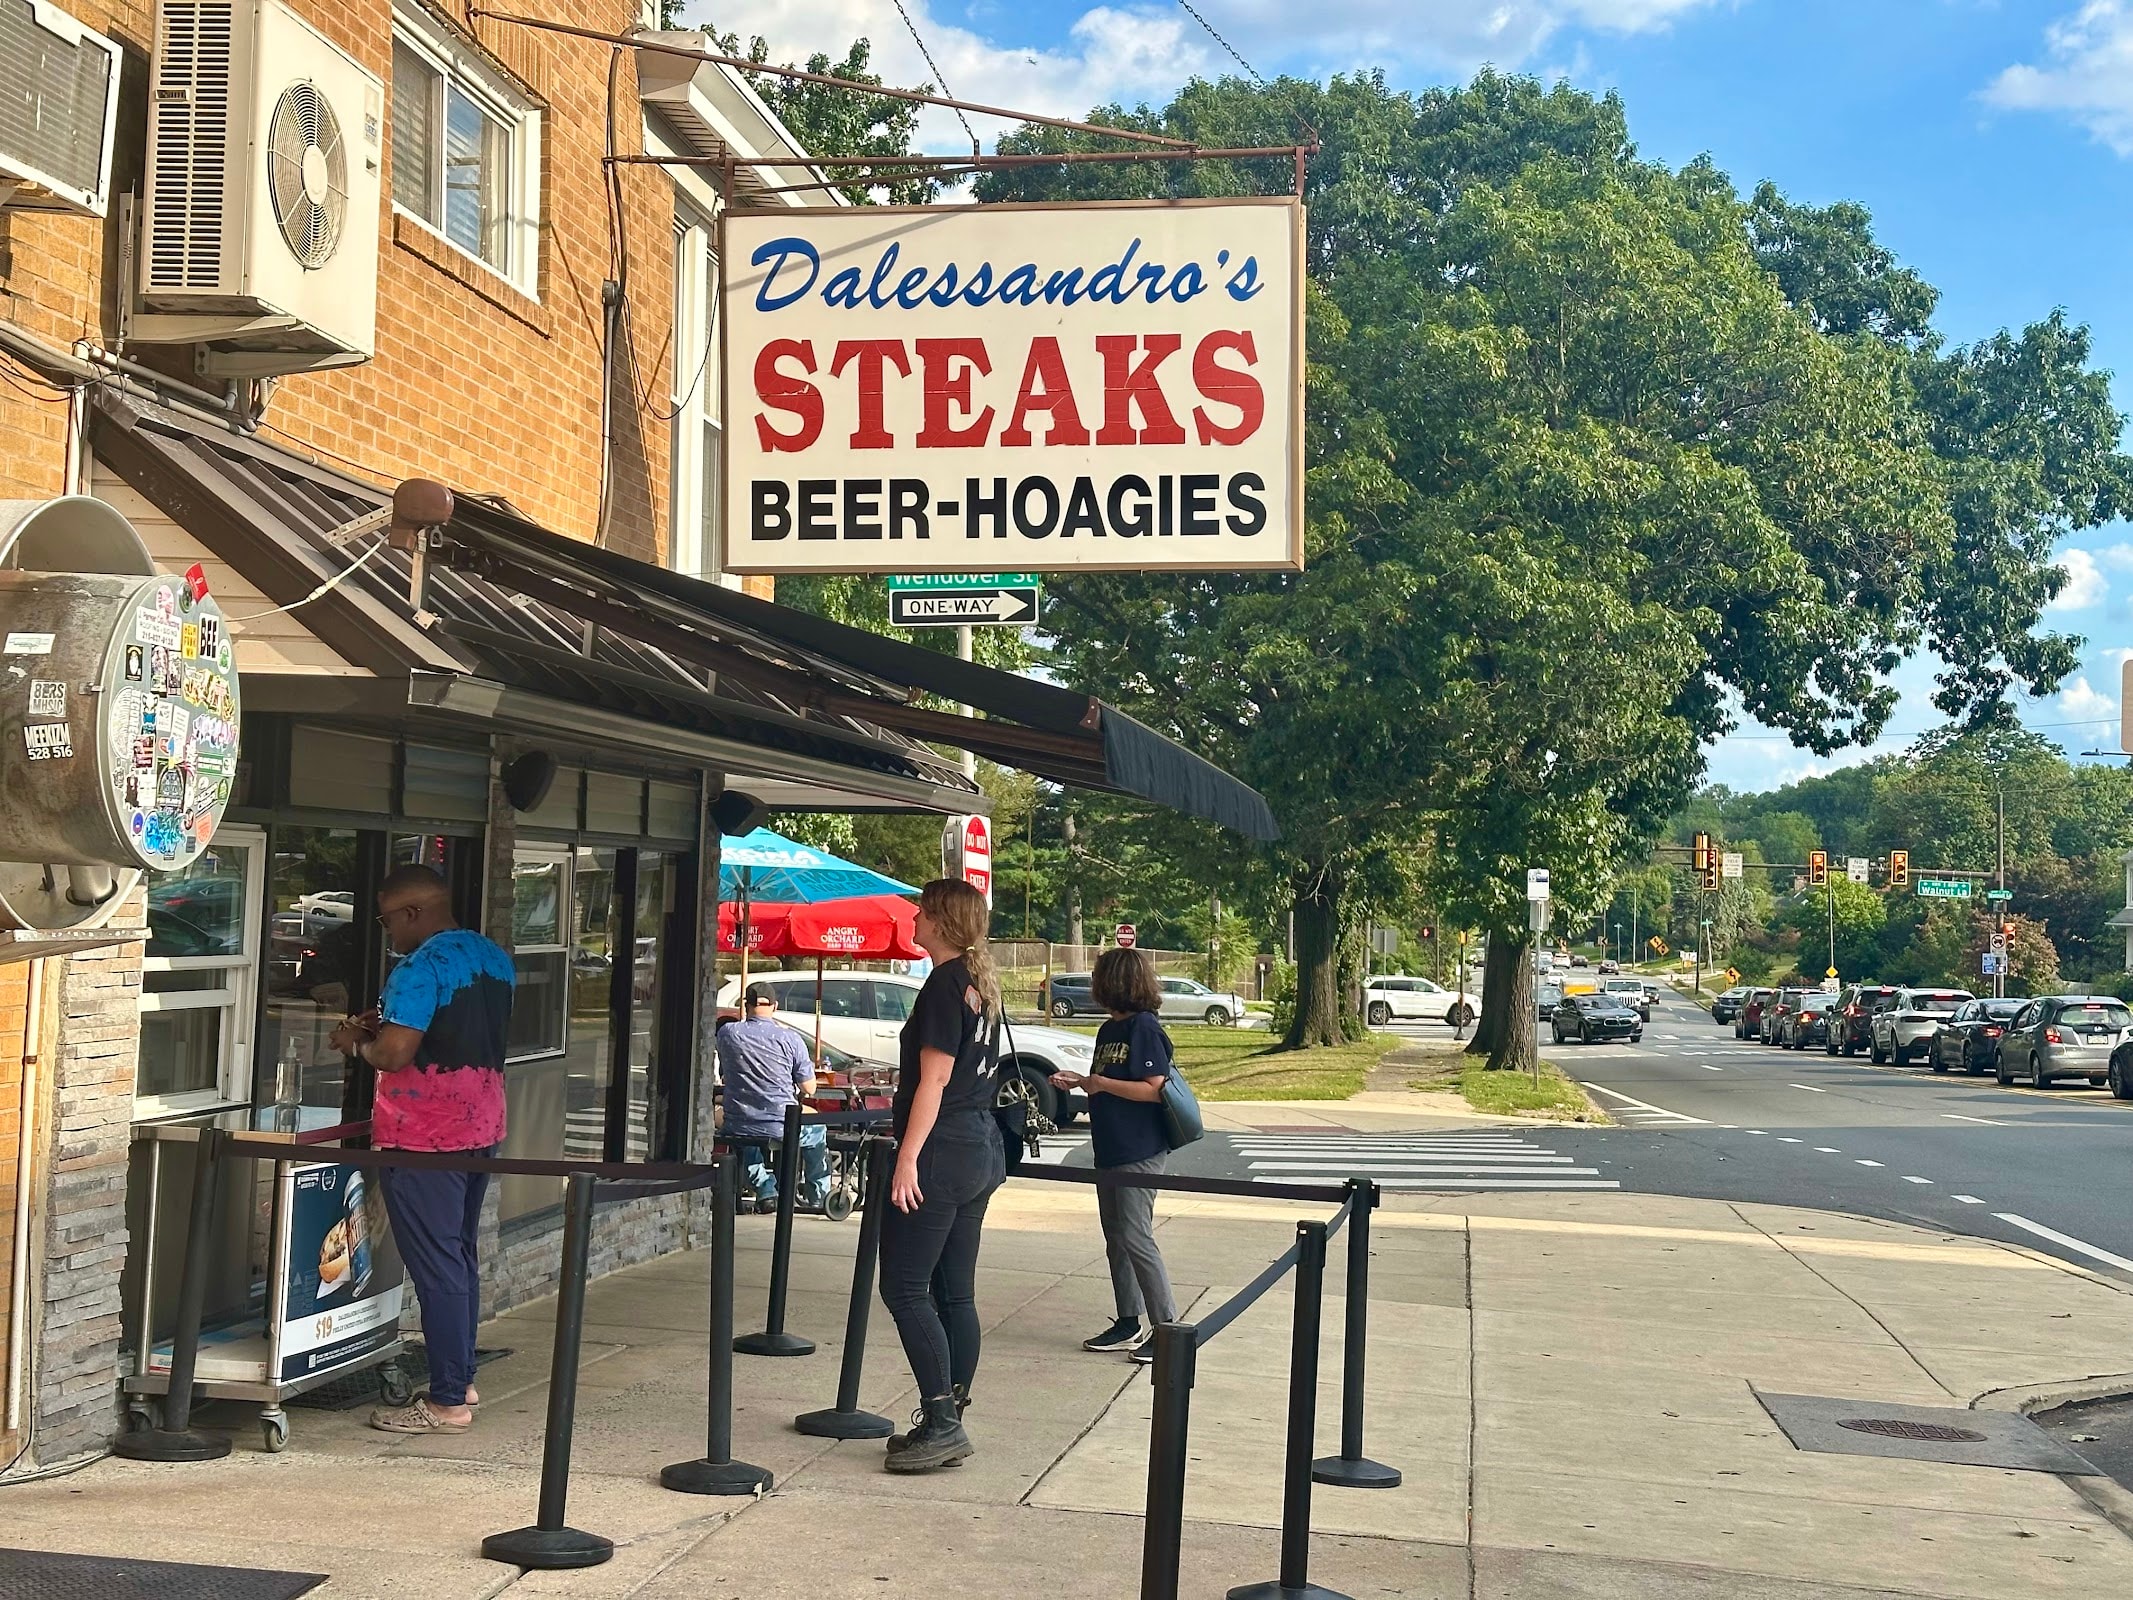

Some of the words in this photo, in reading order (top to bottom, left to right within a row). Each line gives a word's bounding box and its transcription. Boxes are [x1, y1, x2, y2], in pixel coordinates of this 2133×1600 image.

[751, 237, 1264, 313] Dalessandro's
[753, 329, 1265, 453] STEAKS
[751, 472, 1268, 541] BEER-HOAGIES
[910, 600, 948, 613] ONE
[954, 599, 994, 613] WAY
[200, 617, 217, 659] BEE
[27, 747, 51, 761] 528
[52, 745, 73, 758] 516
[1921, 886, 1955, 895] Walnut
[1957, 887, 1967, 896] La
[820, 935, 865, 944] ORCHARD
[827, 927, 859, 935] ANGRY
[315, 1315, 332, 1341] $19
